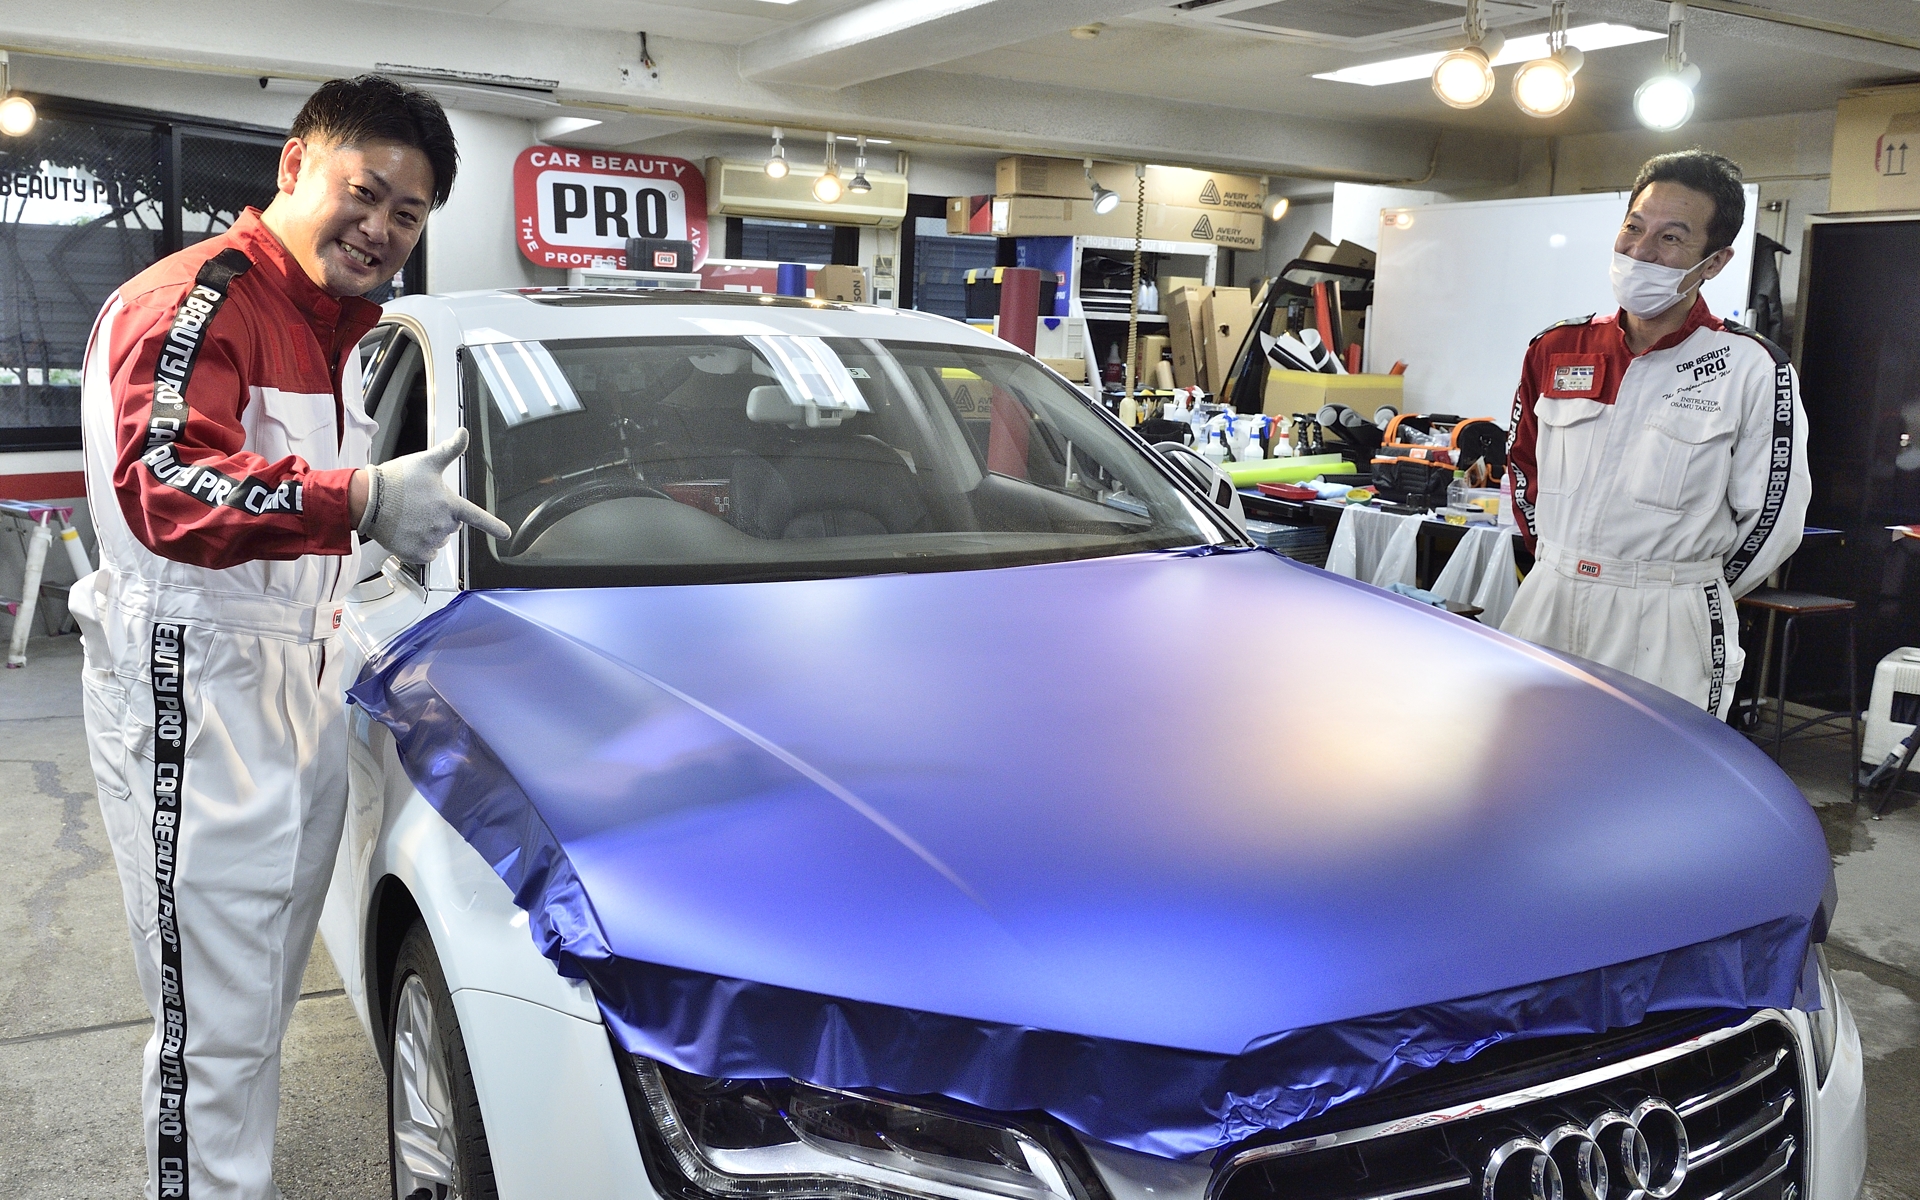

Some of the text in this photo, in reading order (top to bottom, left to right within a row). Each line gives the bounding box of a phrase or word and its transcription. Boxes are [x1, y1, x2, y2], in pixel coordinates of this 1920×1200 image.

[530, 152, 686, 178] CAR BEAUTY
[0, 173, 86, 202] BEAUTY
[1224, 191, 1249, 200] AVERY
[1223, 200, 1262, 209] DENNISON
[522, 216, 539, 253] THE
[1111, 237, 1137, 249] Light
[1216, 235, 1255, 245] DENNISON
[1217, 227, 1241, 235] AVERY
[1676, 345, 1730, 373] CAR BEAUTY
[1670, 402, 1694, 410] OSAMU
[1681, 397, 1719, 406] INSTRUCTOR
[1773, 437, 1790, 468] CAR
[191, 471, 238, 506] PR
[1759, 471, 1786, 526] BEAUTY
[1581, 564, 1597, 573] PRO
[1712, 635, 1724, 665] CAR
[156, 762, 179, 807] CAR
[154, 810, 177, 897] BEAUTY
[162, 963, 181, 1007] CAR
[161, 1010, 184, 1090] BEAUTY
[160, 1157, 184, 1200] CAR
